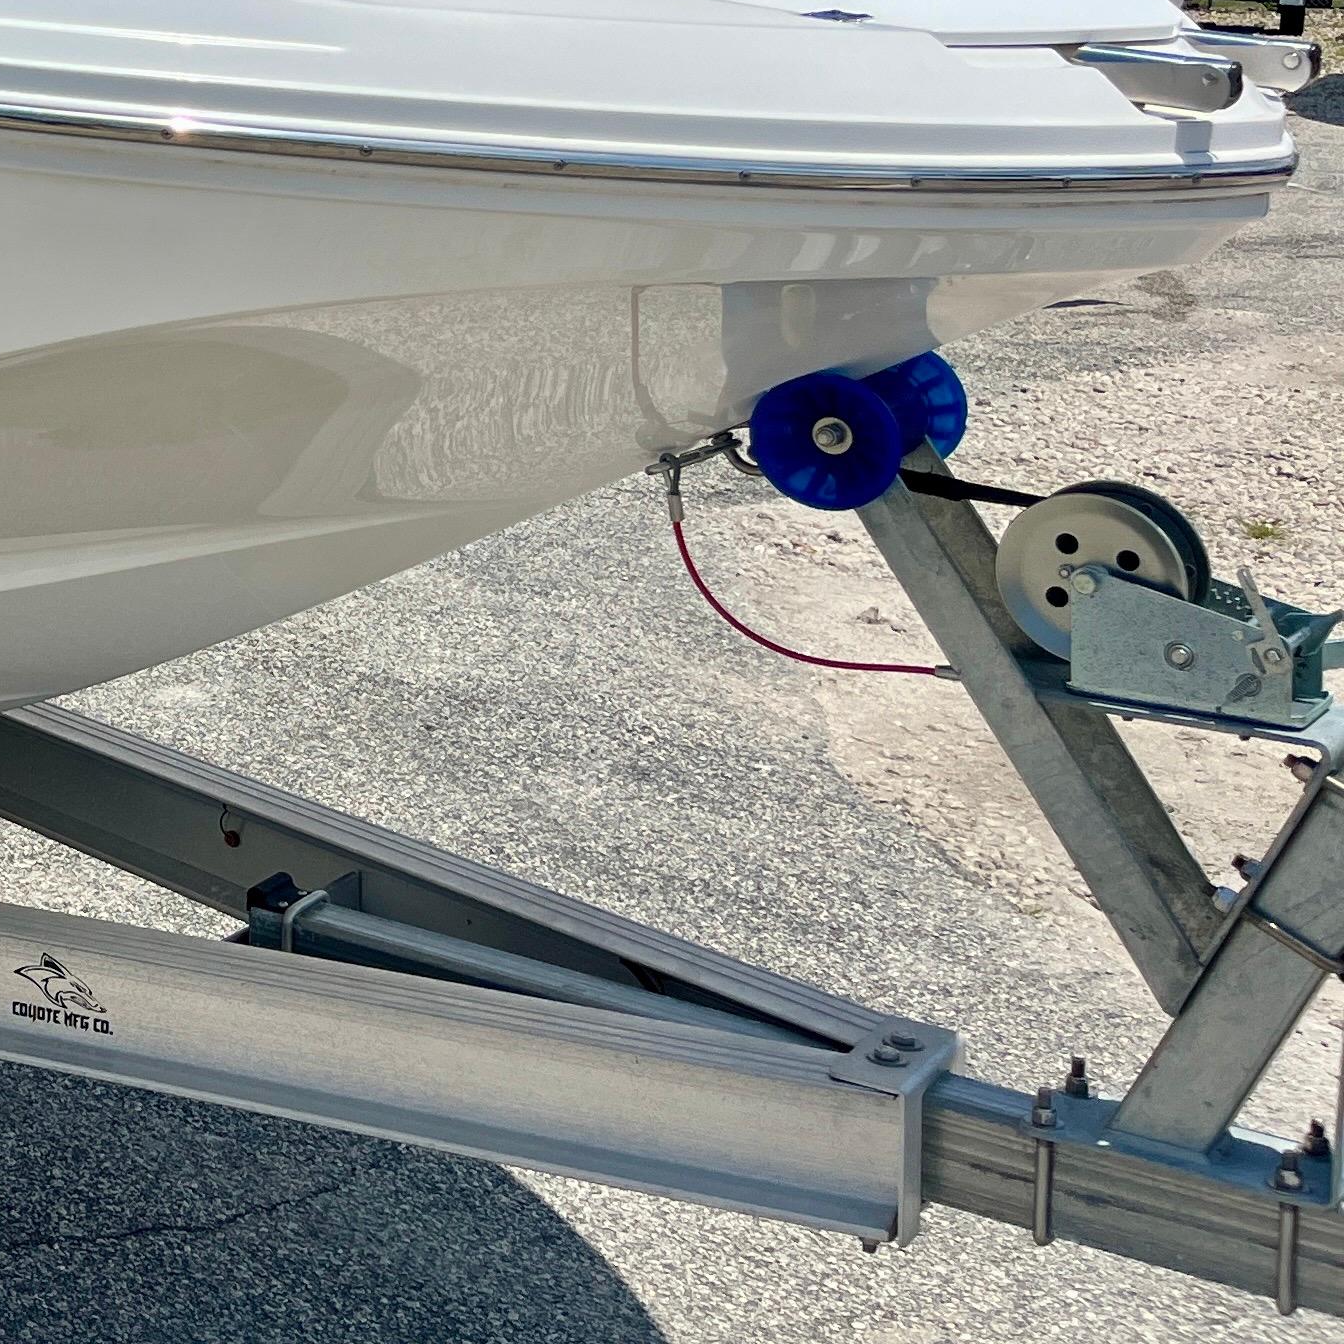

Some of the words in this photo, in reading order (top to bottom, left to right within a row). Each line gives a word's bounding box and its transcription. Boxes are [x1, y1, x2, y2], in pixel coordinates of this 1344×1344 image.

[12, 1001, 61, 1023] COYOTE
[64, 1009, 90, 1031] MFG
[93, 1018, 114, 1035] CO.
